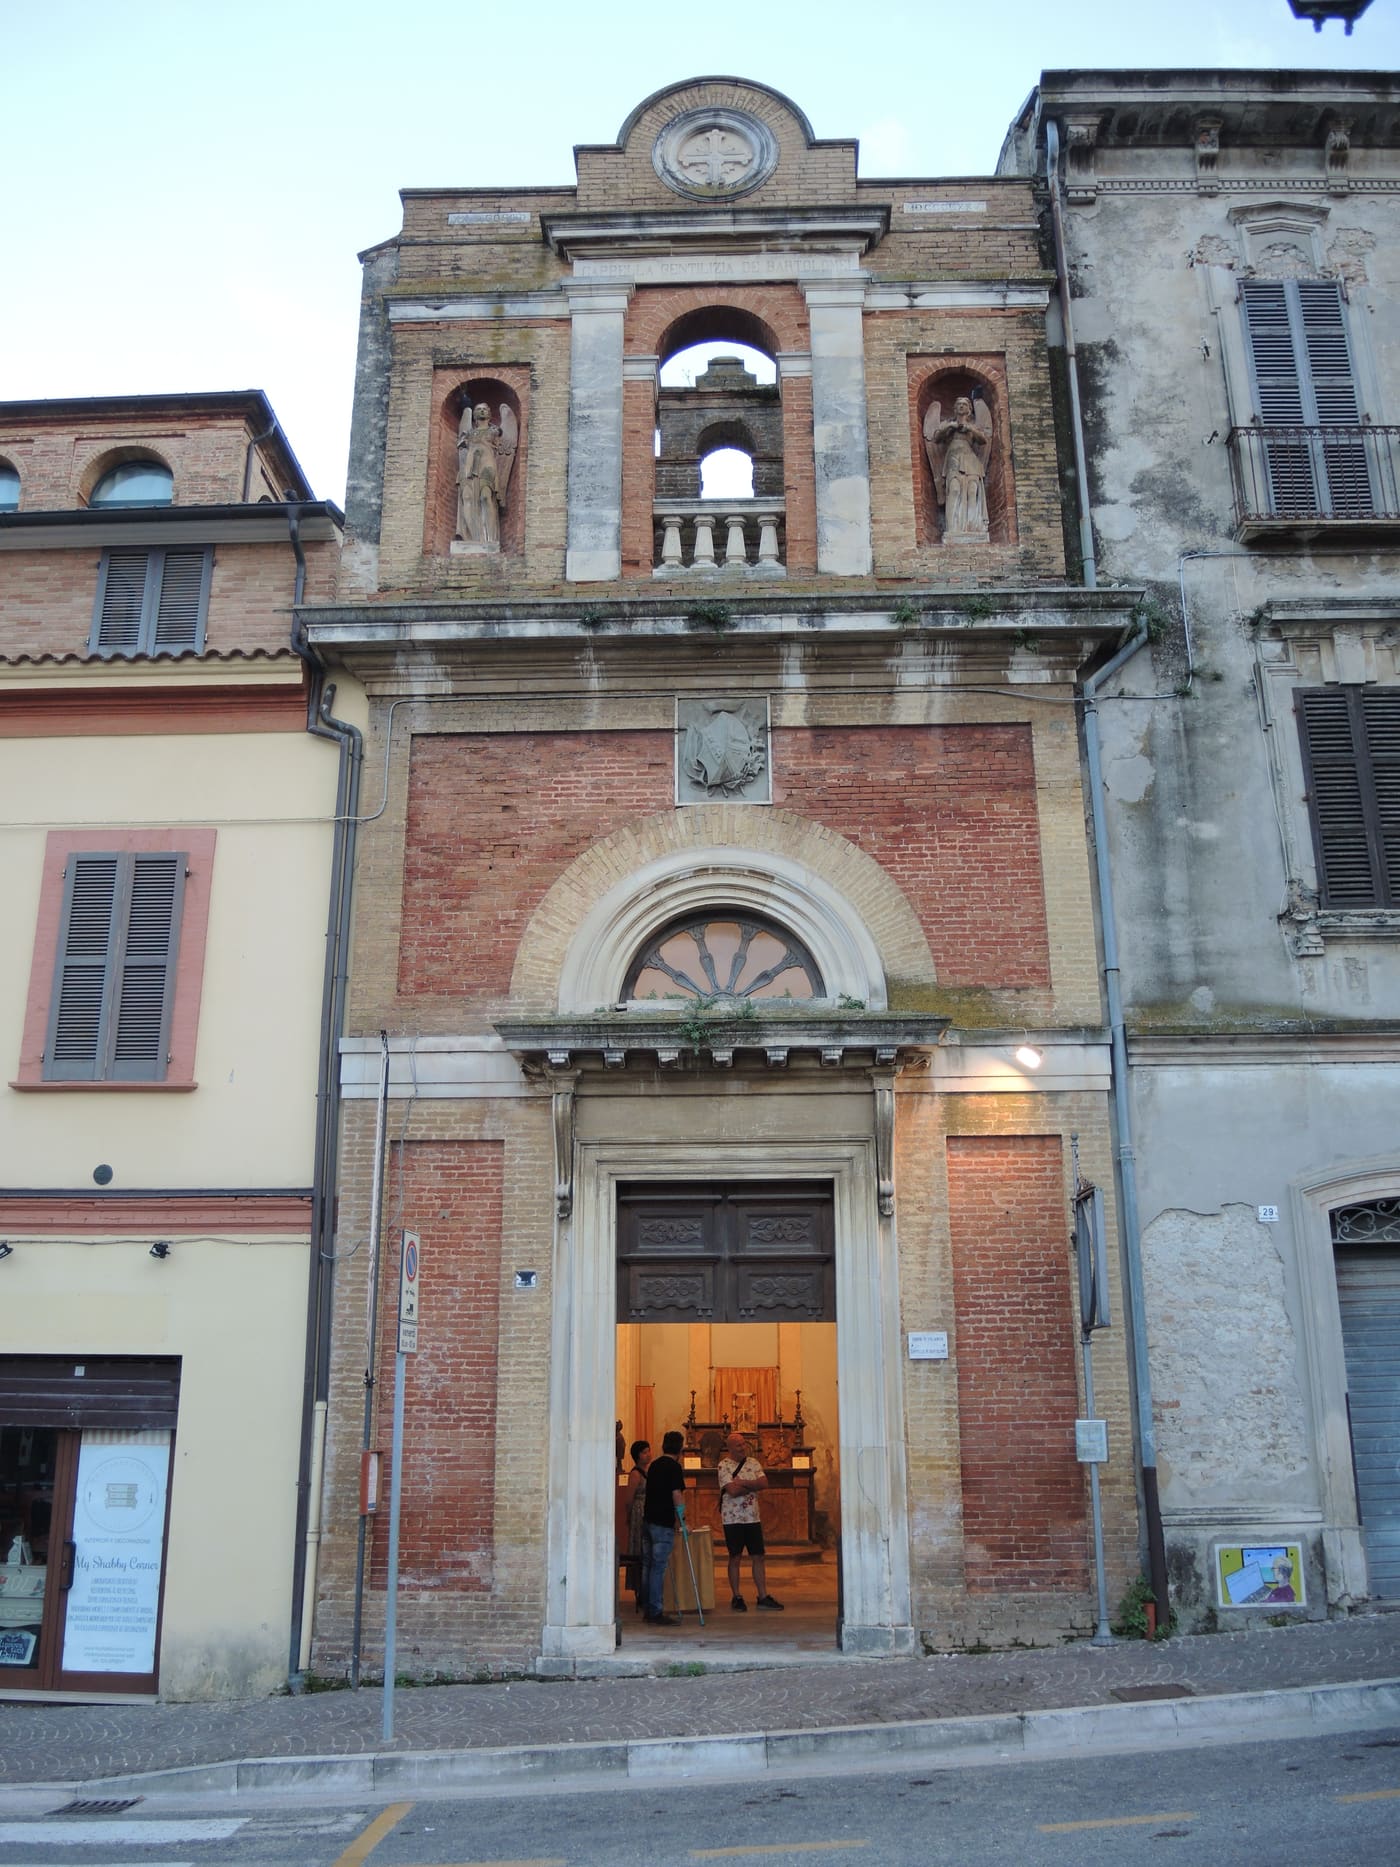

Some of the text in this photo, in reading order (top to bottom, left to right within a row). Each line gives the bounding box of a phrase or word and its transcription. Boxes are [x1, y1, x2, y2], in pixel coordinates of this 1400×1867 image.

[583, 264, 653, 276] CAPPELLA
[660, 262, 733, 275] GENTILIZIA
[1263, 1208, 1273, 1216] 29
[76, 1556, 159, 1572] My Shabby Corner
